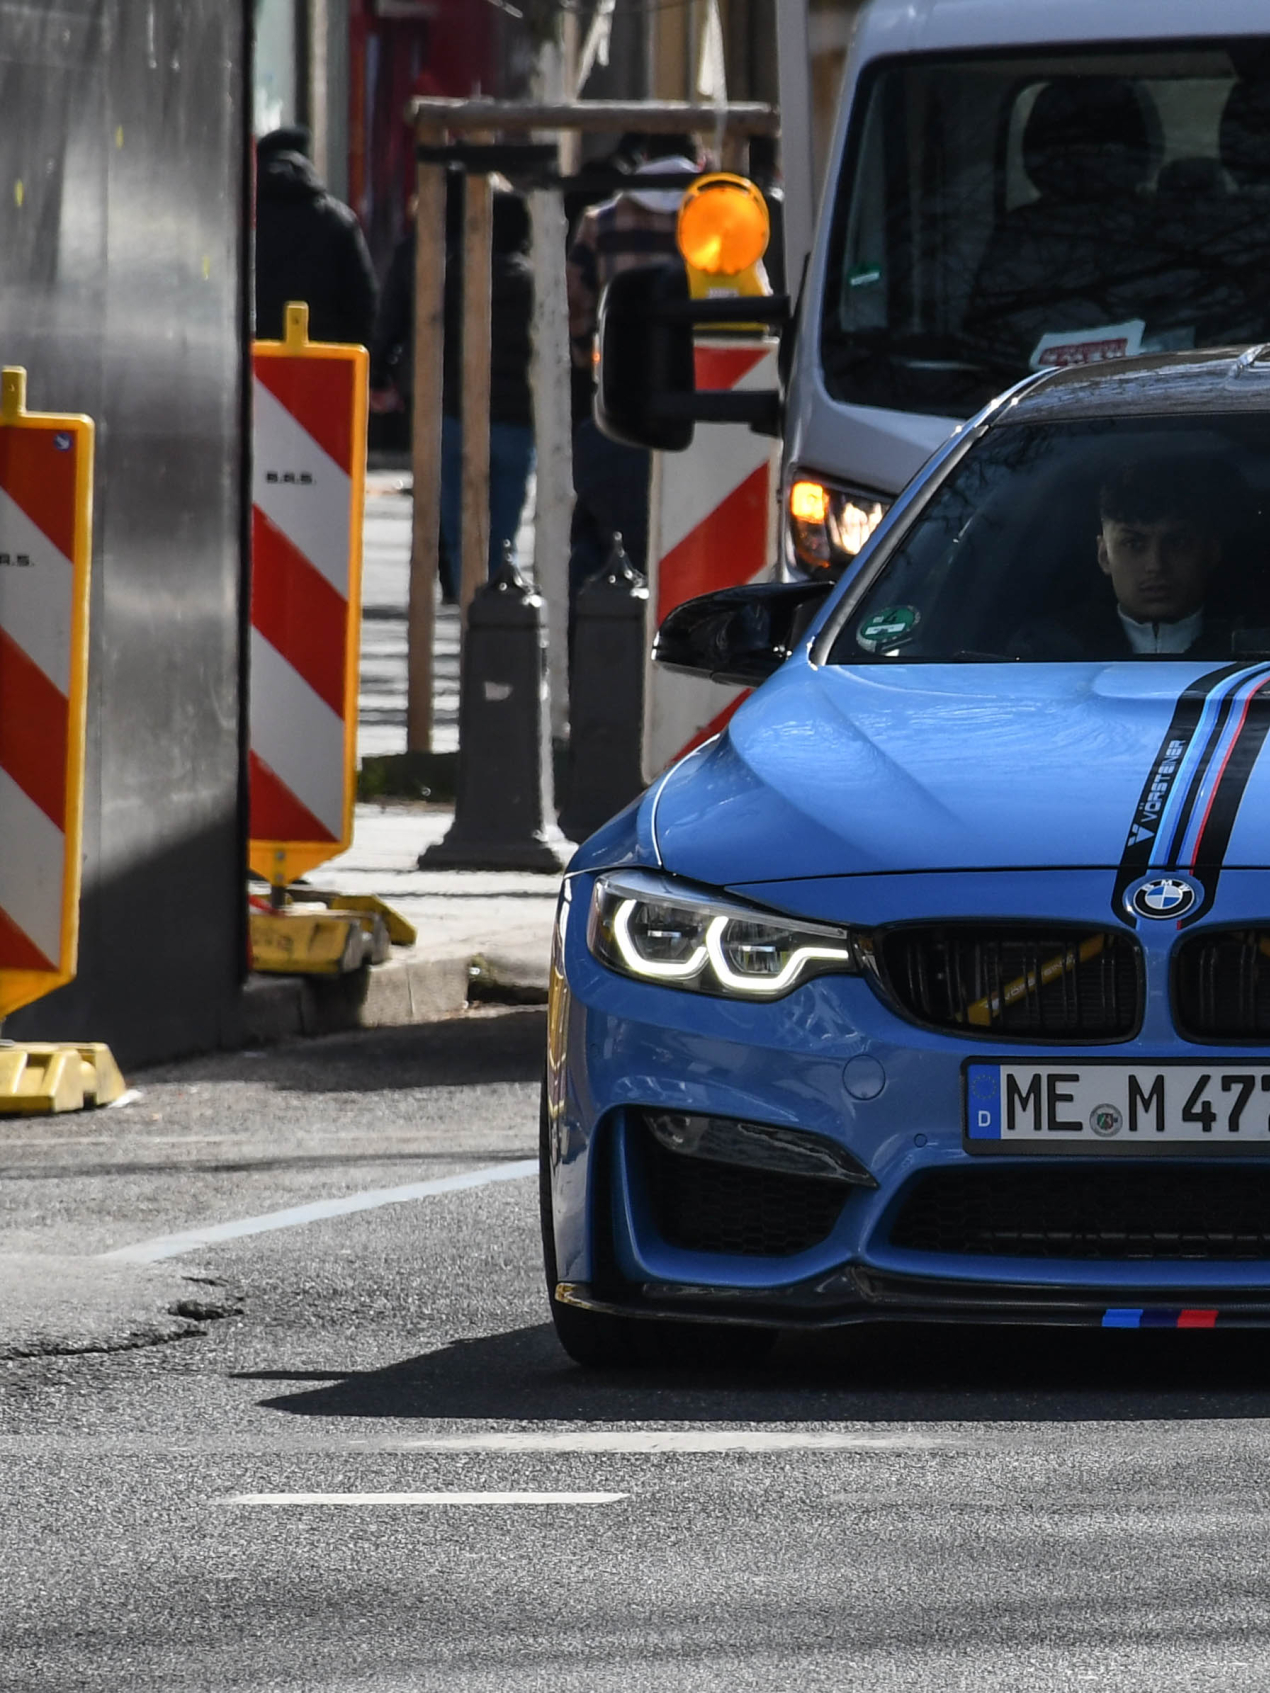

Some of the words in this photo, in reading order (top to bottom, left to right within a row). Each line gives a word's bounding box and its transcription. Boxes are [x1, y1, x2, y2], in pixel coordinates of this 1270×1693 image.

[1139, 740, 1186, 822] VÖRSTEINER
[1140, 879, 1192, 892] BMW
[978, 1111, 991, 1127] D
[1006, 1073, 1083, 1132] ME
[1128, 1074, 1165, 1132] M
